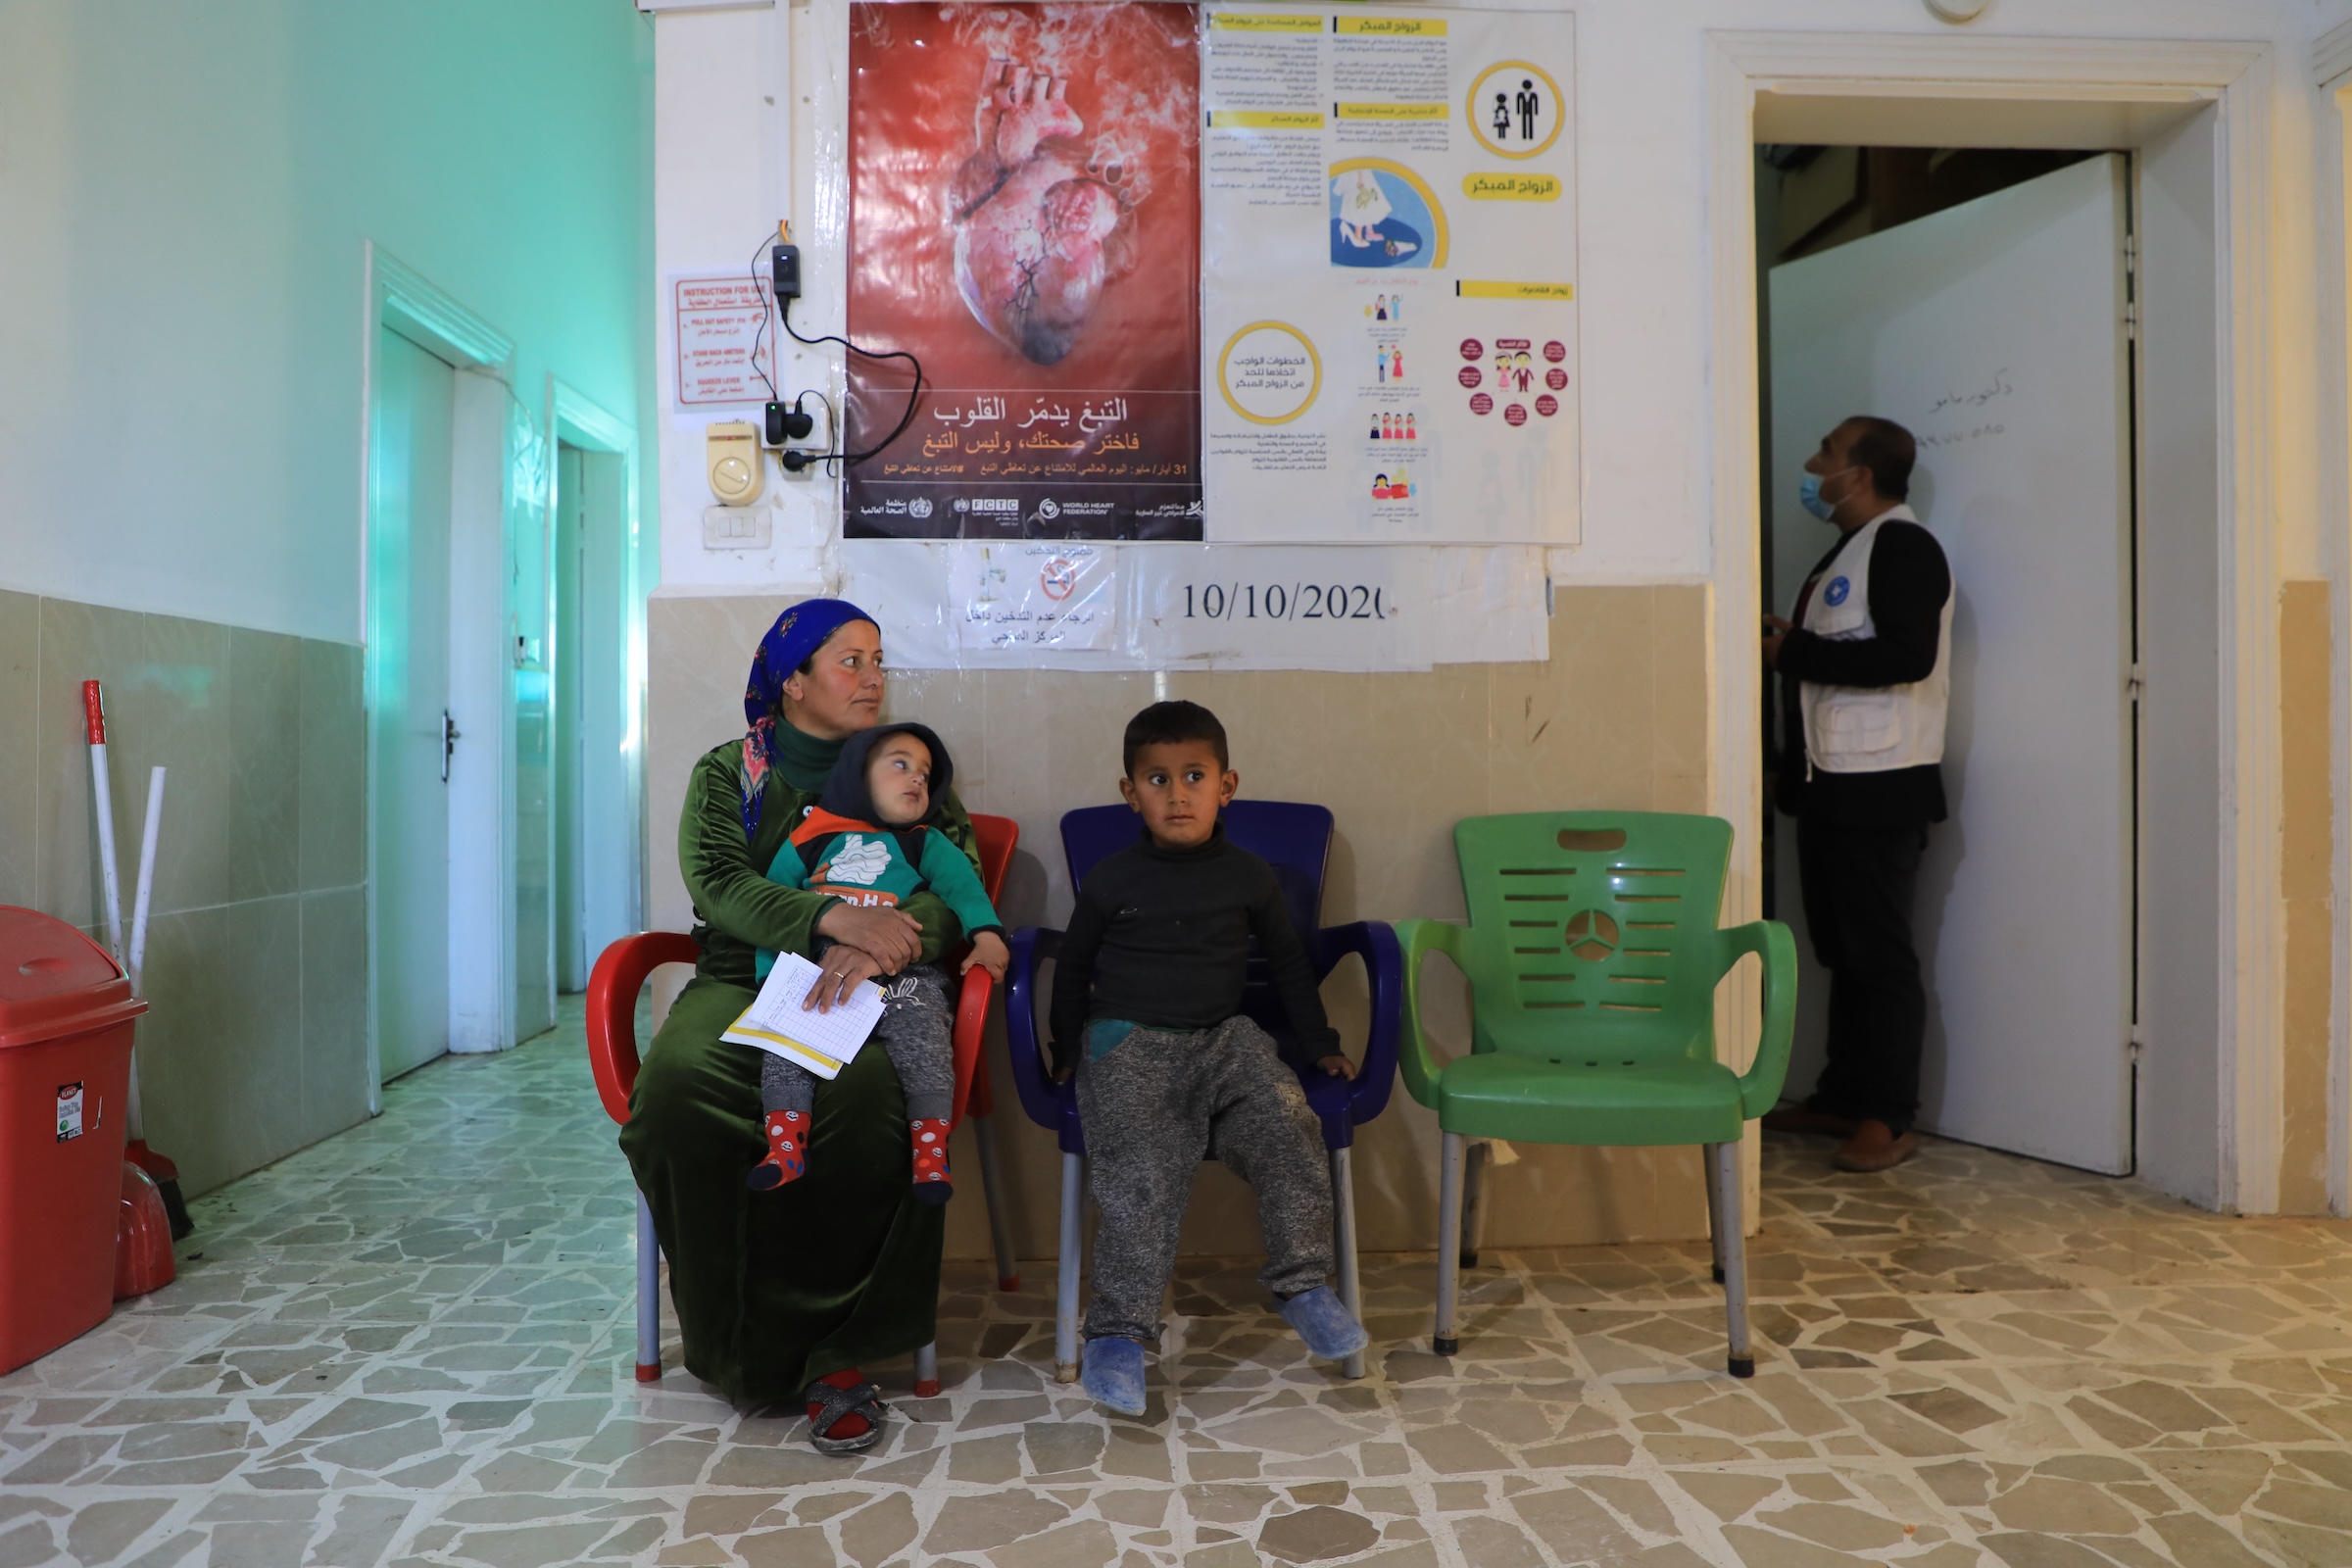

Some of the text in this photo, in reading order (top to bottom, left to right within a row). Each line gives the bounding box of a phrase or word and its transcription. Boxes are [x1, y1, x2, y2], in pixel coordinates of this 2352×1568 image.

[1359, 20, 1421, 33] الزواج المبكر
[1472, 178, 1553, 194] الزواج المبكر
[683, 286, 733, 296] INSTRUCTION
[1234, 357, 1305, 367] الخطوات الواجب
[1245, 367, 1296, 376] اتخاذها للحد
[1235, 378, 1305, 389] من الزواج المبكر
[933, 396, 1128, 433] التبغ يدمّر القلوب
[922, 431, 1140, 457] فاختر صحتك، وليس التبغ
[884, 464, 899, 475] التبغ
[900, 464, 919, 474] تعاطي
[921, 465, 932, 474] عن
[980, 463, 998, 476] التبغ
[1000, 463, 1027, 474] تعاطي
[1029, 465, 1042, 475] عن
[1044, 463, 1076, 476] للامتناع
[1078, 463, 1106, 476] العالمي
[1108, 463, 1127, 475] اليوم
[1173, 465, 1188, 475] 31
[886, 498, 907, 508] منظمة
[973, 500, 1018, 510] FCTC
[860, 506, 907, 515] الصحة العالمية
[1025, 545, 1060, 557] التدخين
[965, 610, 991, 623] داخل
[994, 611, 1033, 624] التدخين
[1036, 612, 1055, 624] عدم
[992, 631, 1029, 645] الحي
